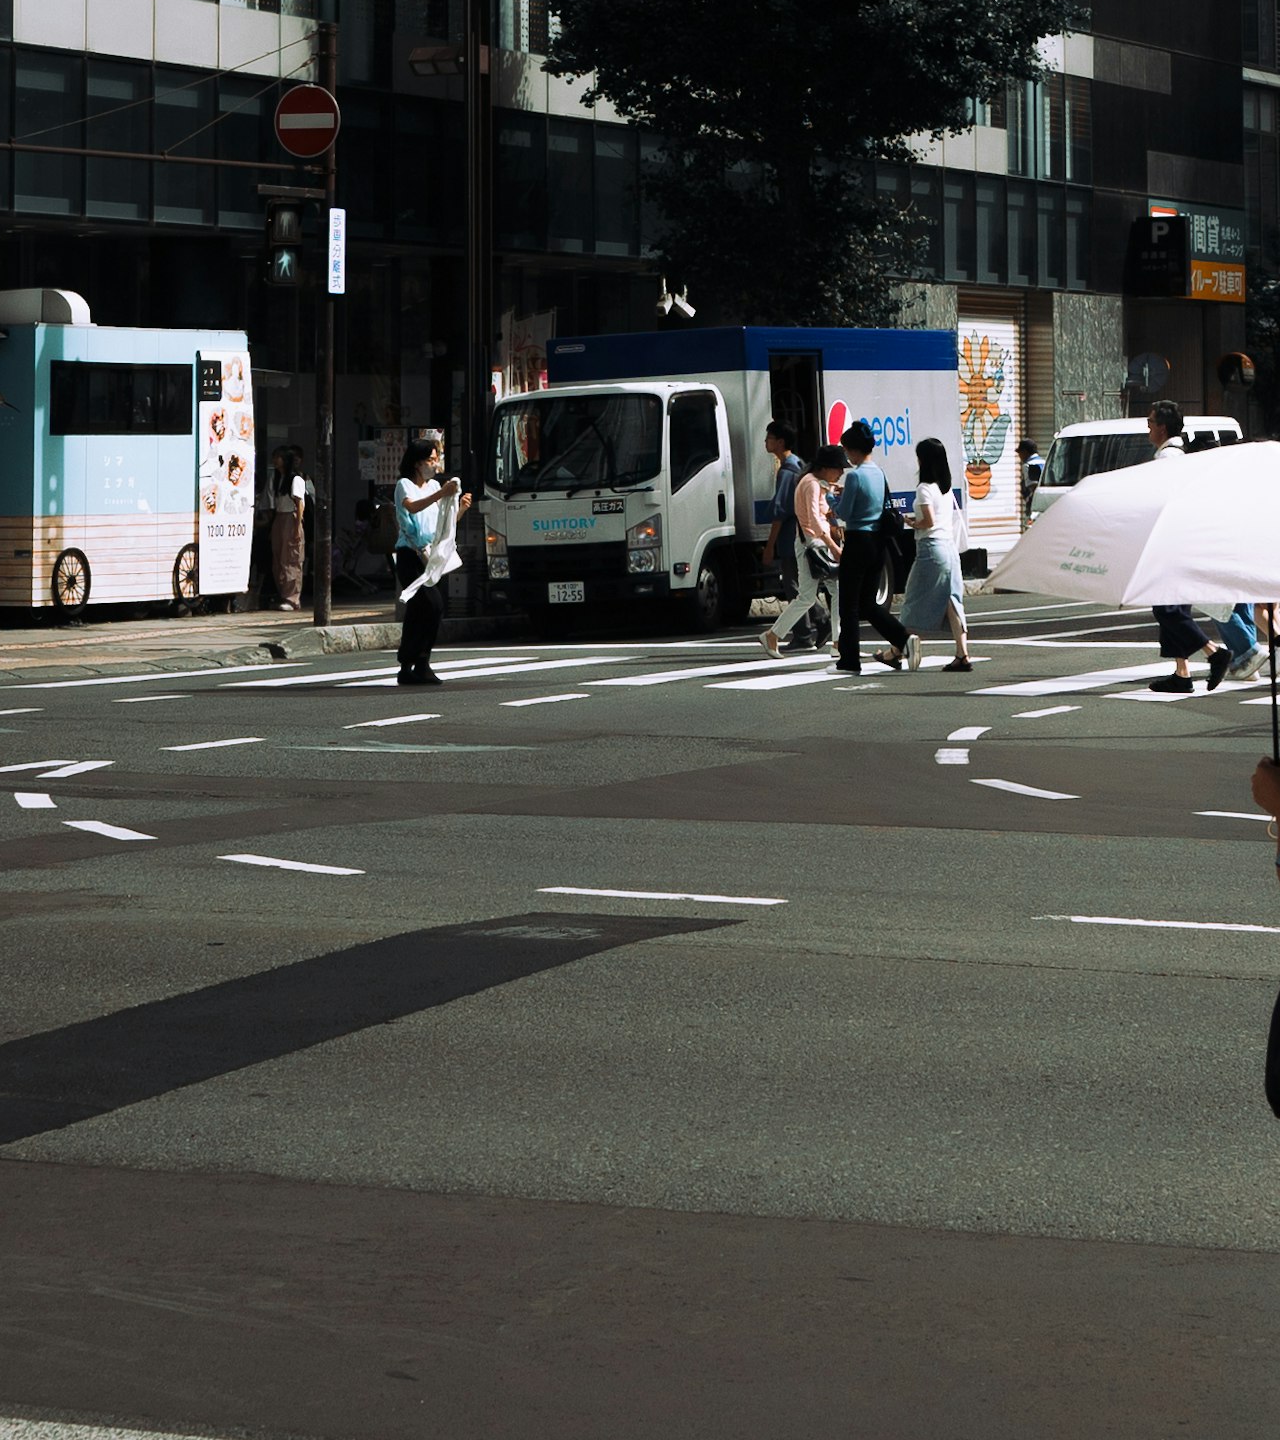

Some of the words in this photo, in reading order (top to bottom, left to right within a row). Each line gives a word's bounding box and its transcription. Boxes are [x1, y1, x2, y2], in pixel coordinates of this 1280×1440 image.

[1151, 221, 1170, 244] P
[1190, 213, 1221, 256] 間貸
[593, 501, 624, 512] 高圧ガス
